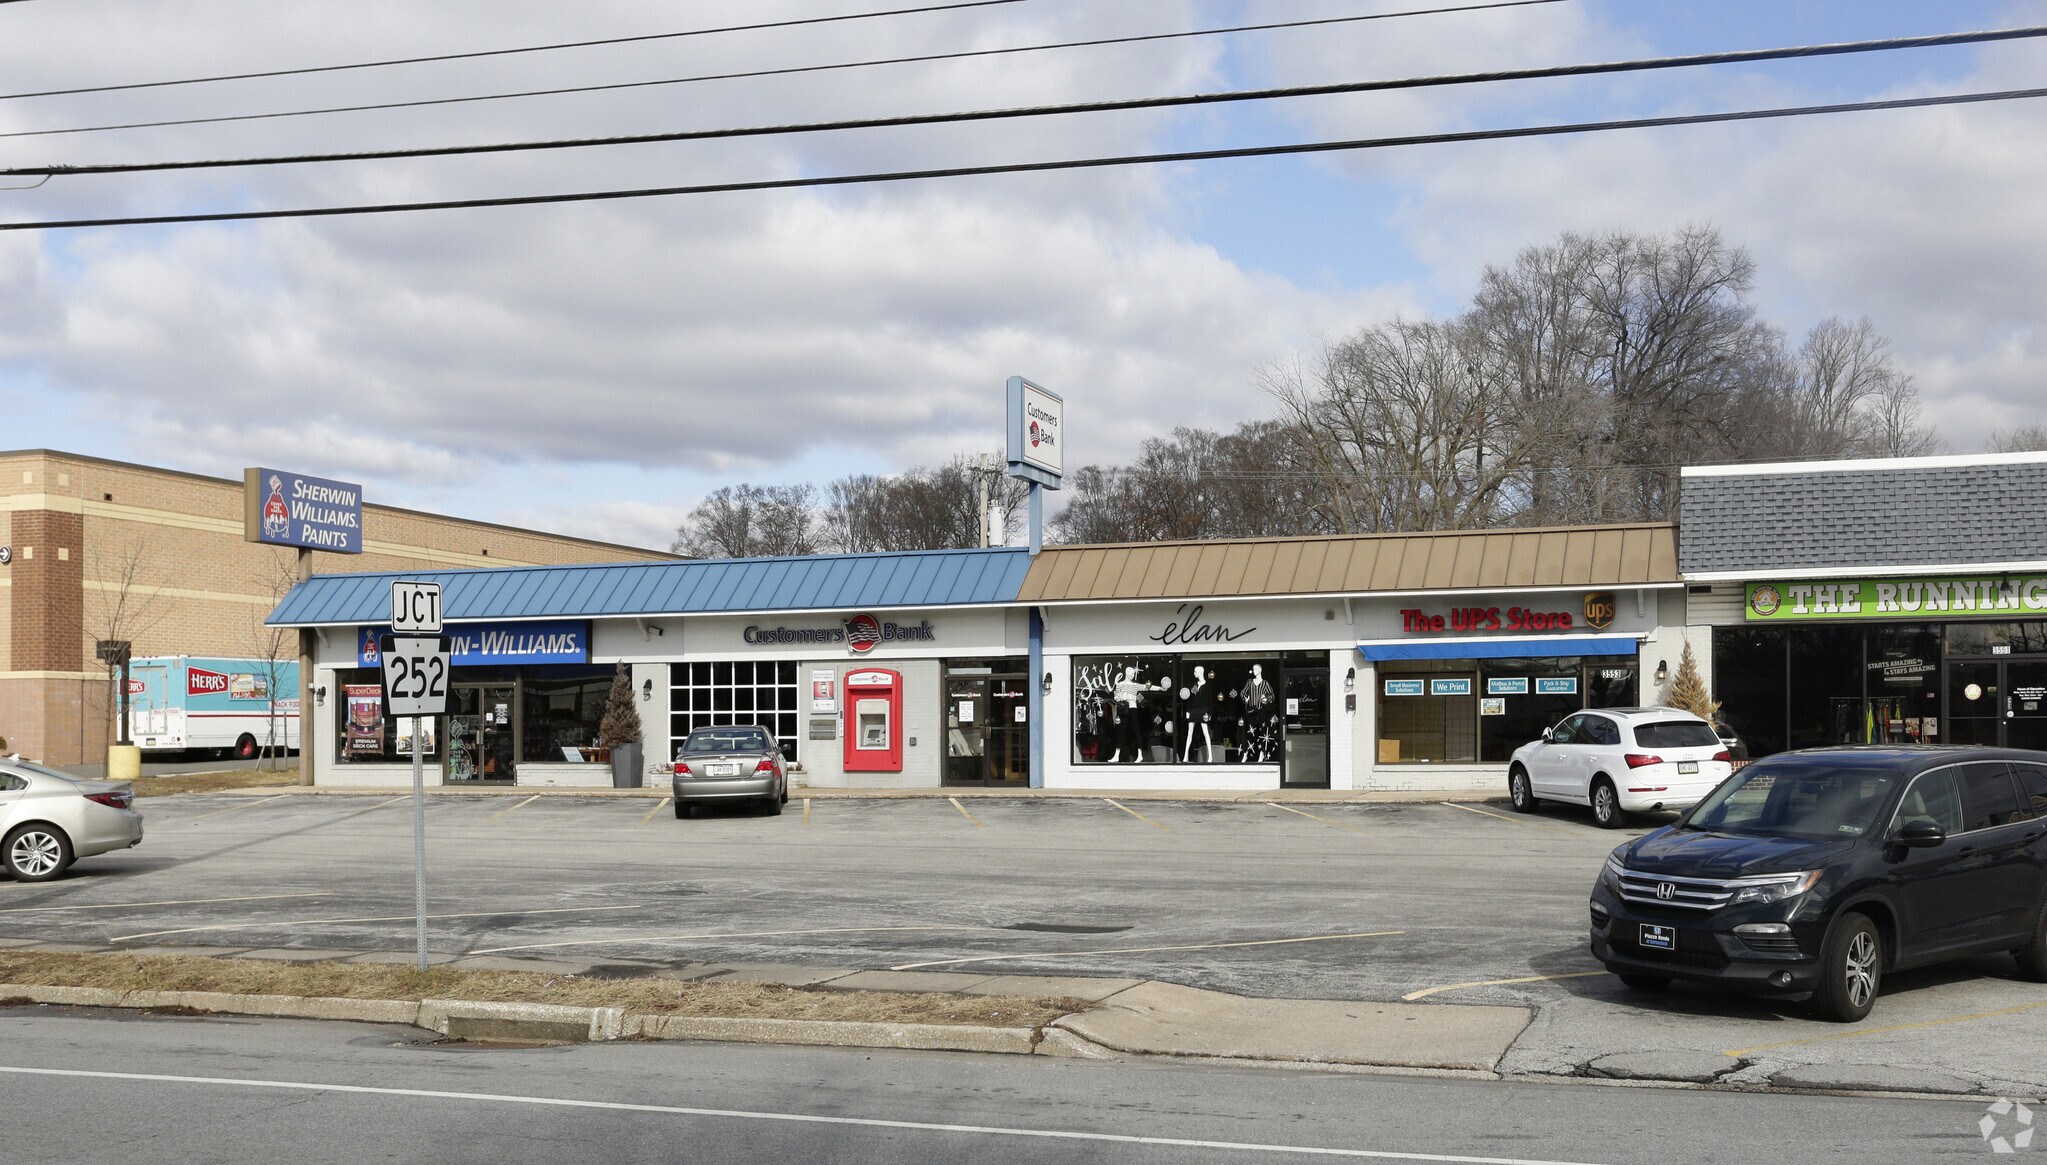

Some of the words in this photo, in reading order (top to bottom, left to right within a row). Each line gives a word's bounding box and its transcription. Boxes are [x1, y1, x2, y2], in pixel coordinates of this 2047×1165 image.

[1028, 402, 1057, 427] Customers
[1041, 429, 1055, 446] Bank
[292, 479, 356, 507] SHERWIN
[292, 500, 357, 528] WILLIAMS
[301, 524, 348, 547] PAINTS
[396, 591, 438, 623] JCT
[1788, 583, 1862, 614] THE
[1875, 579, 2047, 612] RUNNING
[1149, 603, 1257, 645] élan
[1400, 609, 1445, 633] The
[1451, 607, 1501, 632] UPS
[1507, 606, 1573, 631] Store
[1586, 603, 1614, 624] ups
[450, 631, 577, 656] IN-WILLIAMS
[743, 626, 844, 644] Customers
[883, 621, 934, 641] Bank
[1602, 669, 1621, 679] 3553
[1867, 661, 1889, 669] STARTS
[1890, 658, 1917, 667] AMAZING
[1890, 667, 1908, 675] STAYS
[1908, 664, 1936, 673] AMAZING
[191, 673, 225, 690] HERR'S
[391, 656, 444, 698] 252
[1078, 662, 1123, 701] Sale
[1437, 683, 1448, 691] We
[1449, 682, 1466, 691] Print
